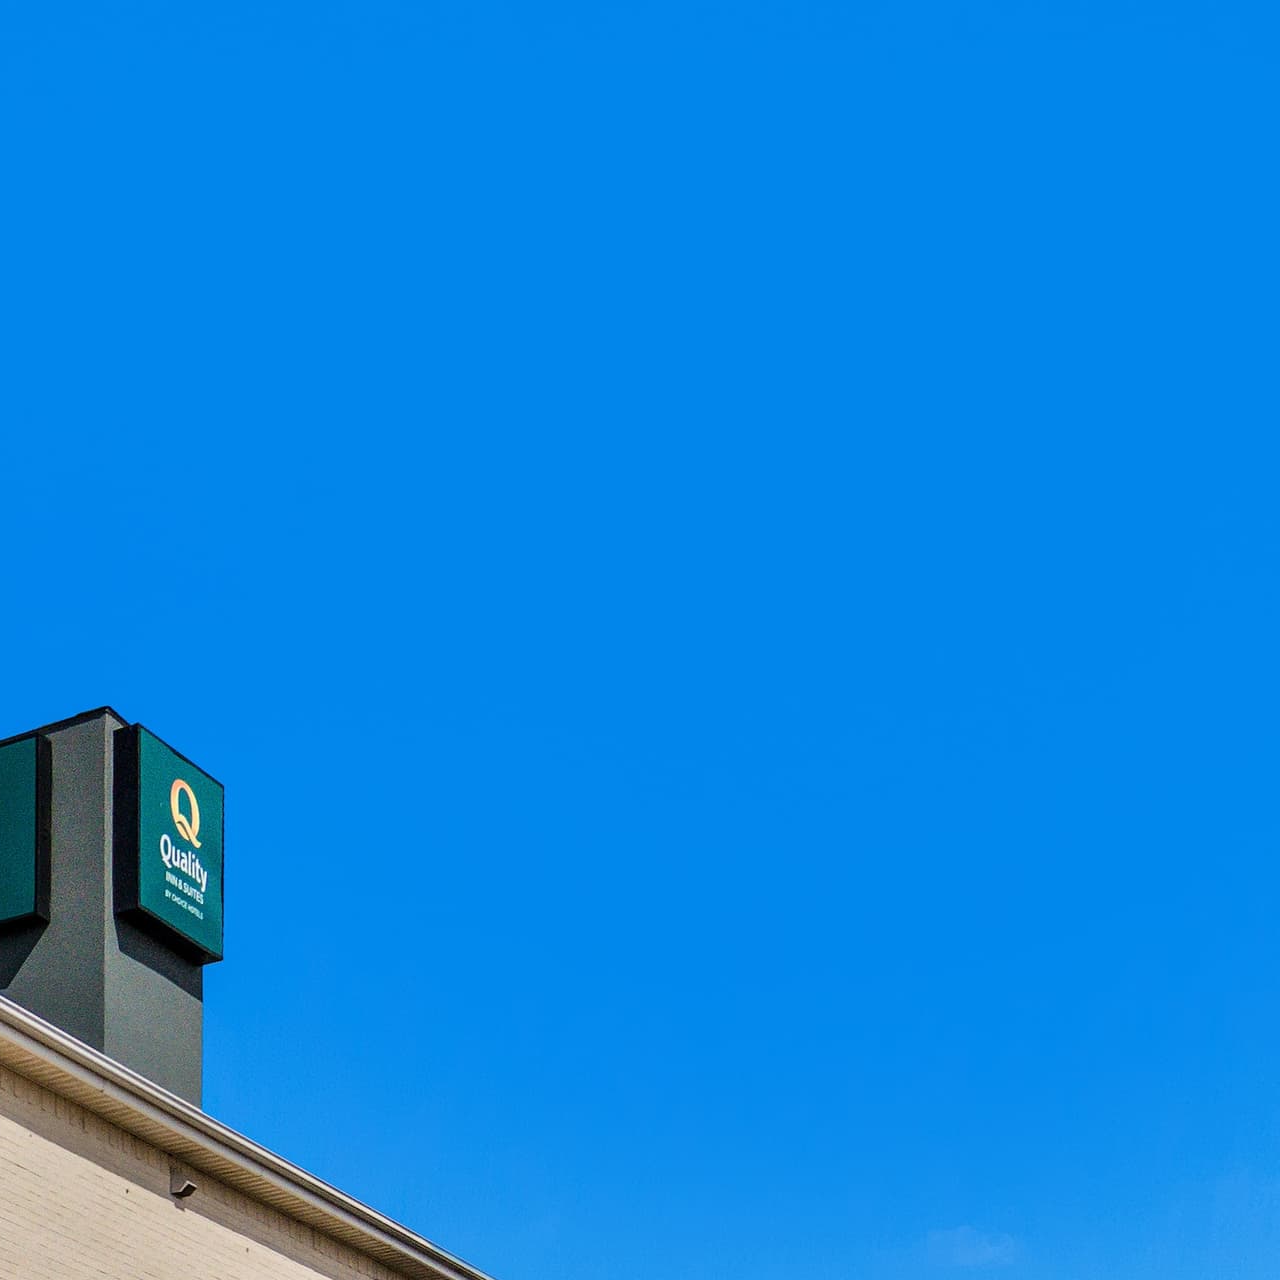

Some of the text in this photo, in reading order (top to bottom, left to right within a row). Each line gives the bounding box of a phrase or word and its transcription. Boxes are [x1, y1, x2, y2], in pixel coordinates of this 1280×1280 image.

[171, 779, 202, 848] Q
[160, 834, 208, 893] Quality
[183, 882, 204, 905] SUITES
